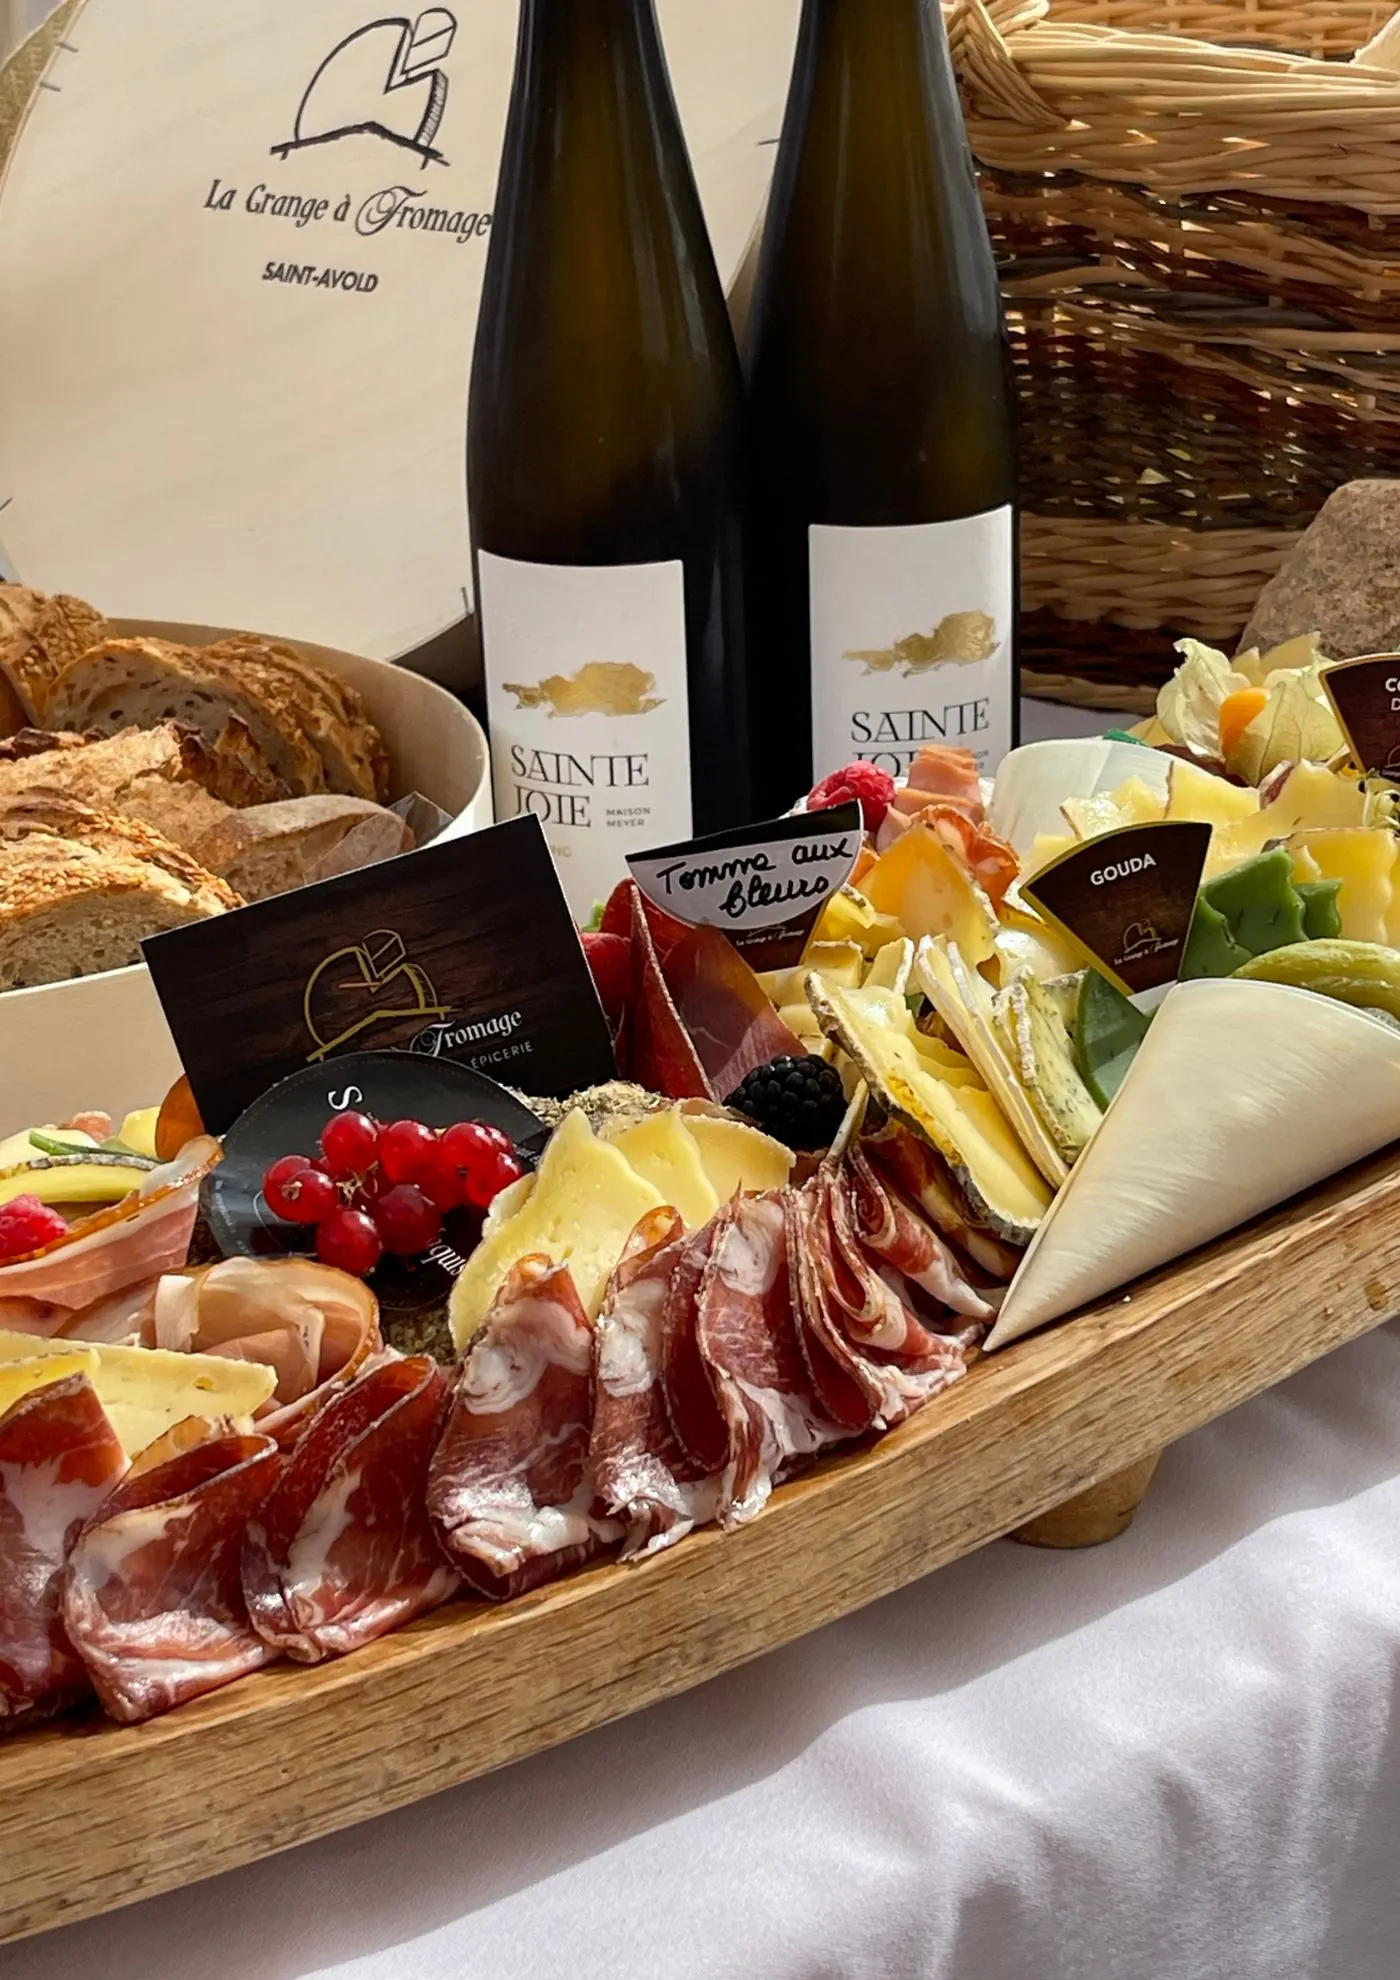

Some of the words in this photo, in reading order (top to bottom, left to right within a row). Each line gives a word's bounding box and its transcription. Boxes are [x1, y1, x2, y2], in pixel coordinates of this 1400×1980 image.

[203, 178, 238, 211] La
[245, 183, 329, 229] Grange
[333, 193, 352, 222] à
[354, 185, 493, 244] Fromage
[261, 260, 379, 293] SAINT-AVOLD
[850, 697, 990, 743] SAINTE
[510, 744, 650, 787] SAINTE
[514, 784, 592, 828] JOIE
[606, 807, 651, 816] MAISON
[606, 819, 645, 828] MEYER
[655, 852, 777, 895] Tomme
[791, 837, 853, 865] aux
[1090, 852, 1157, 886] GOUDA
[410, 1010, 523, 1058] Fromage
[470, 1040, 535, 1070] ÉPICERIE
